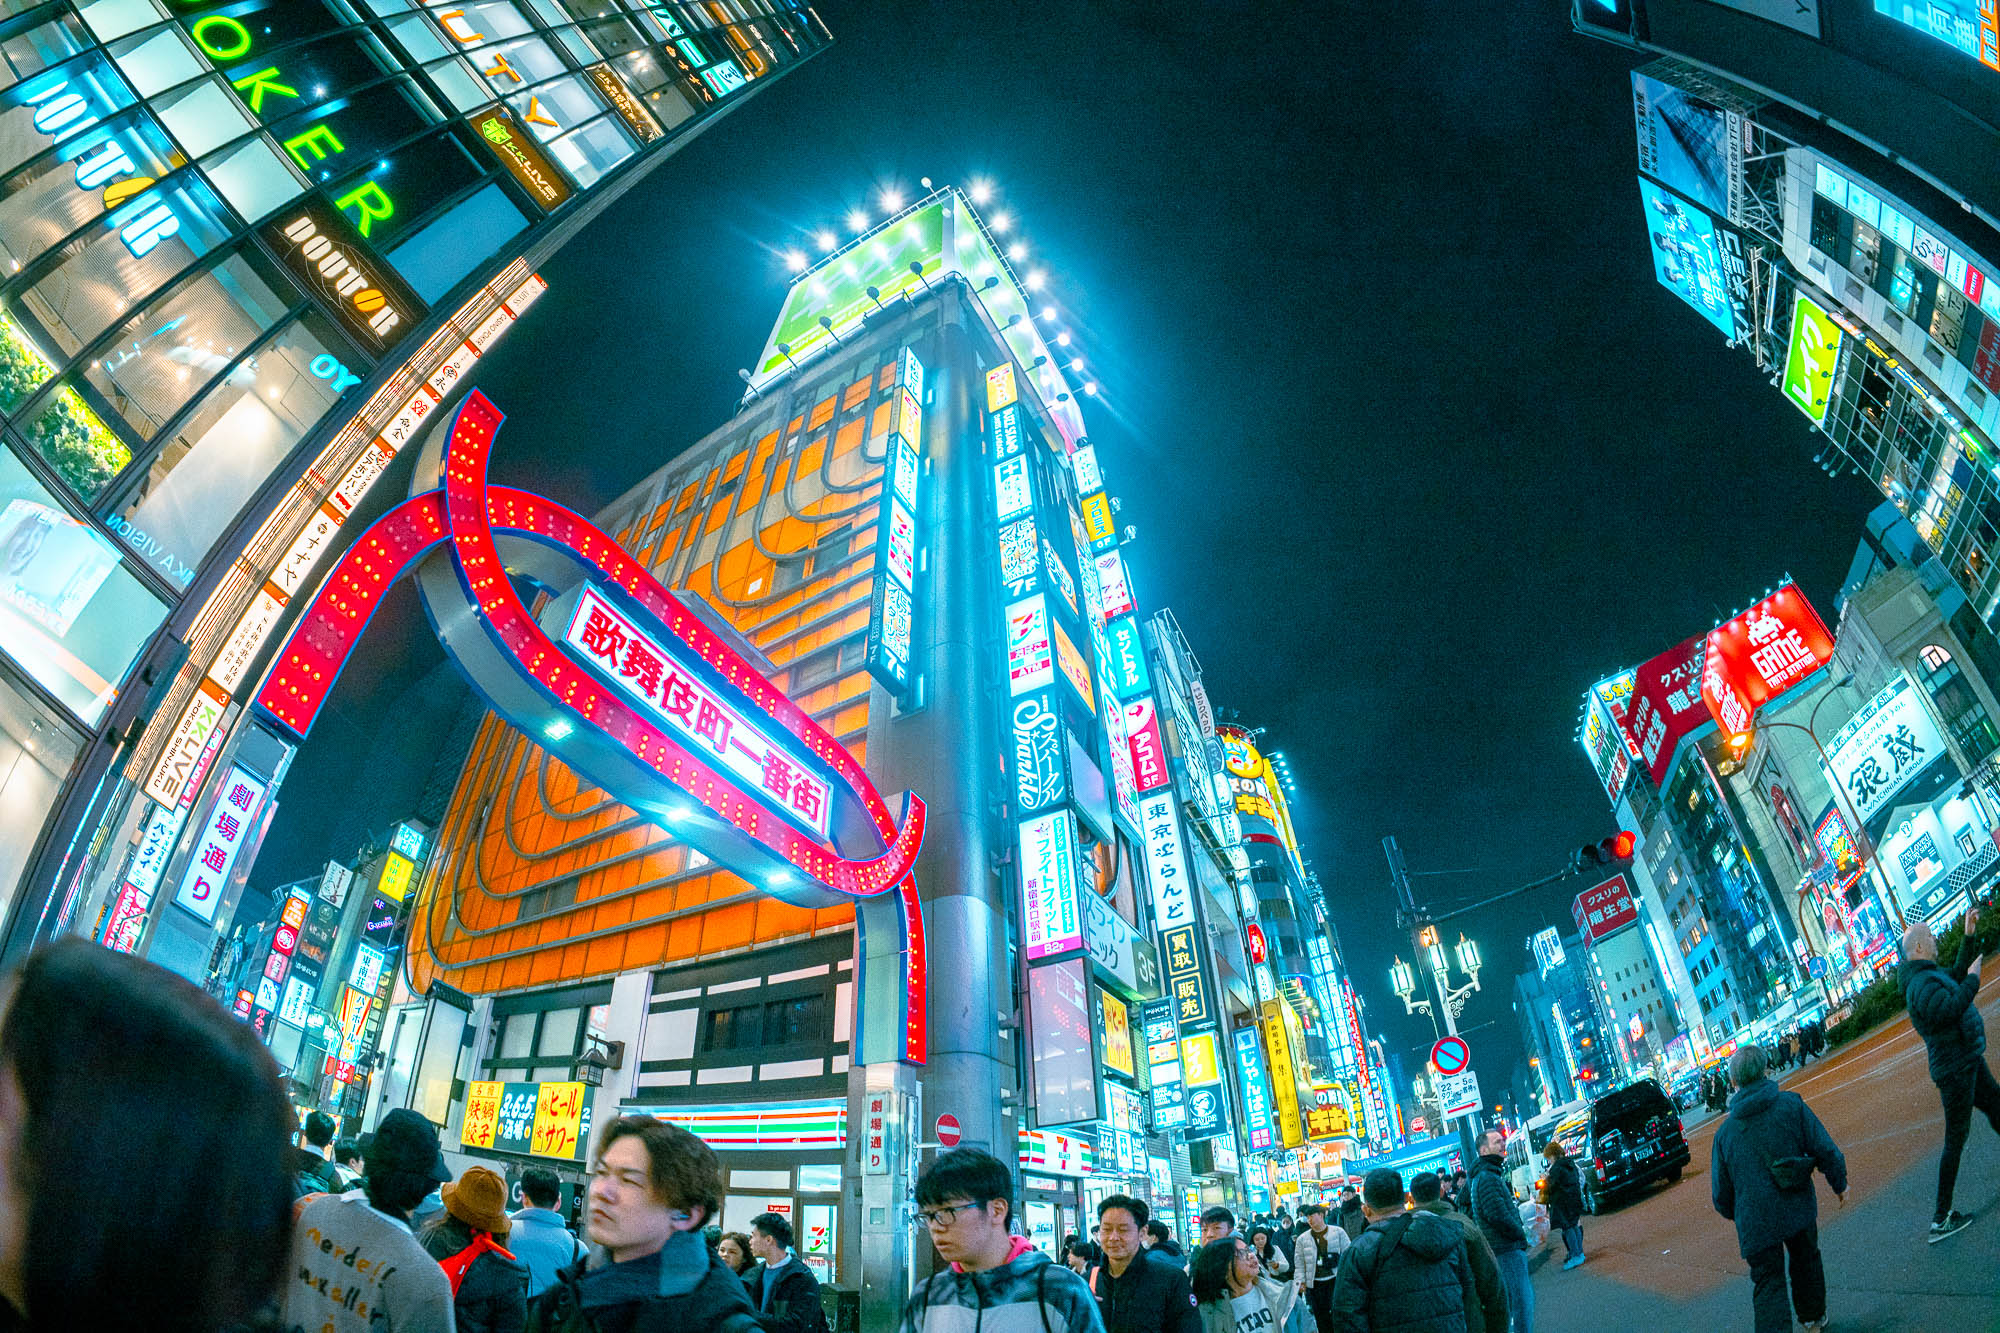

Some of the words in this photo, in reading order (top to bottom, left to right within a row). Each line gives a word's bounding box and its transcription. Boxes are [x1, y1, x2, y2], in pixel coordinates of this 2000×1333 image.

[186, 0, 394, 238] OKER
[284, 216, 399, 338] DOUTOR
[335, 517, 343, 525] 5
[284, 537, 319, 587] すずや
[279, 597, 288, 606] 4
[1007, 576, 1038, 597] 7F
[885, 647, 906, 681] 7F
[1751, 628, 1810, 680] GAME
[1766, 670, 1788, 689] TAITO
[1788, 651, 1817, 678] STATION
[180, 699, 203, 734] POKER
[218, 694, 227, 704] 3
[580, 604, 822, 822] 歌舞伎町一番街
[1633, 695, 1651, 738] クスリの
[1878, 688, 1898, 708] Shop
[153, 736, 184, 788] SHINJUKU
[162, 704, 216, 800] KKLIVE
[1039, 731, 1065, 807] スパークル
[1134, 731, 1158, 776] アコム
[1143, 774, 1159, 788] 3F
[1864, 775, 1903, 813] WATCHNIAN
[1904, 756, 1924, 776] GROUP
[192, 783, 255, 901] 劇場通り
[1036, 837, 1059, 939] ファイトフィット
[1587, 885, 1621, 906] クスリの
[1027, 879, 1042, 941] 新宿東口駅前
[1588, 895, 1632, 927] 龍生堂
[1171, 933, 1194, 970] 買取
[1178, 980, 1201, 1018] 販売
[1187, 1039, 1204, 1079] レイク
[467, 1100, 495, 1122] 鉄鍋
[550, 1087, 580, 1120] ビール
[580, 1107, 592, 1136] 2F
[464, 1121, 490, 1146] 餃子
[503, 1119, 525, 1140] 酒場
[545, 1122, 575, 1153] サワー
[870, 1099, 883, 1167] 劇場通り
[1400, 1159, 1444, 1178] UBNADE
